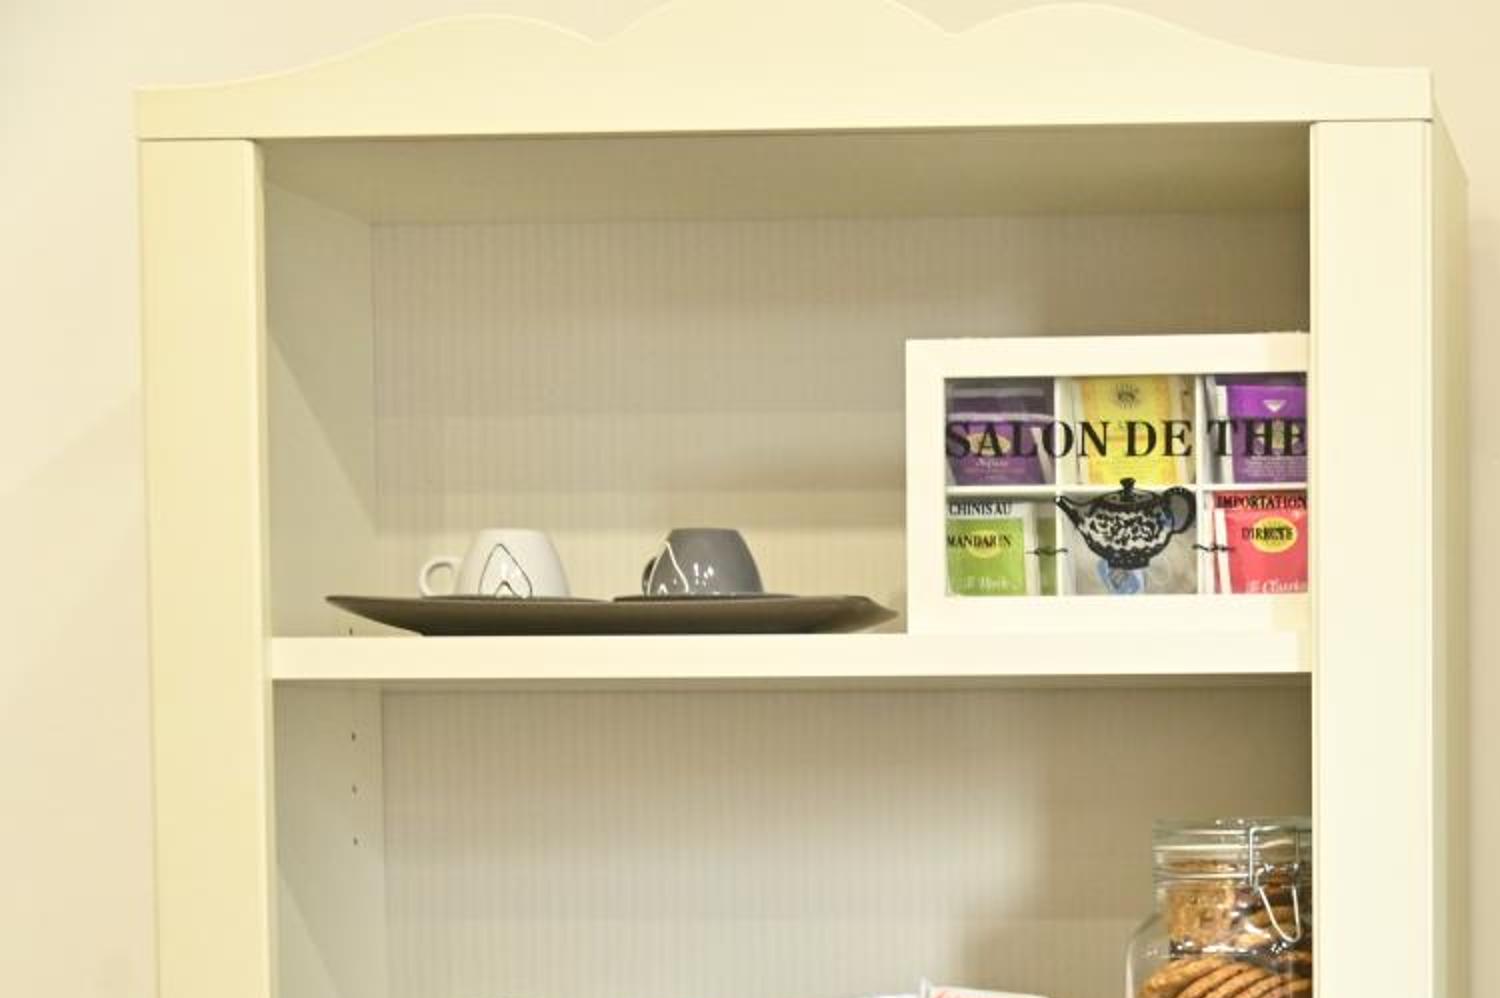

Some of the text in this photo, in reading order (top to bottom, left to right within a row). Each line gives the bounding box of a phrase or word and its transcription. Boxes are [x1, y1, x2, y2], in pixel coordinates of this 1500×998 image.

[946, 420, 1109, 458] SALON
[1124, 419, 1193, 457] DE
[1216, 495, 1308, 509] IMPORTATION
[946, 534, 1012, 548] MANDARIN
